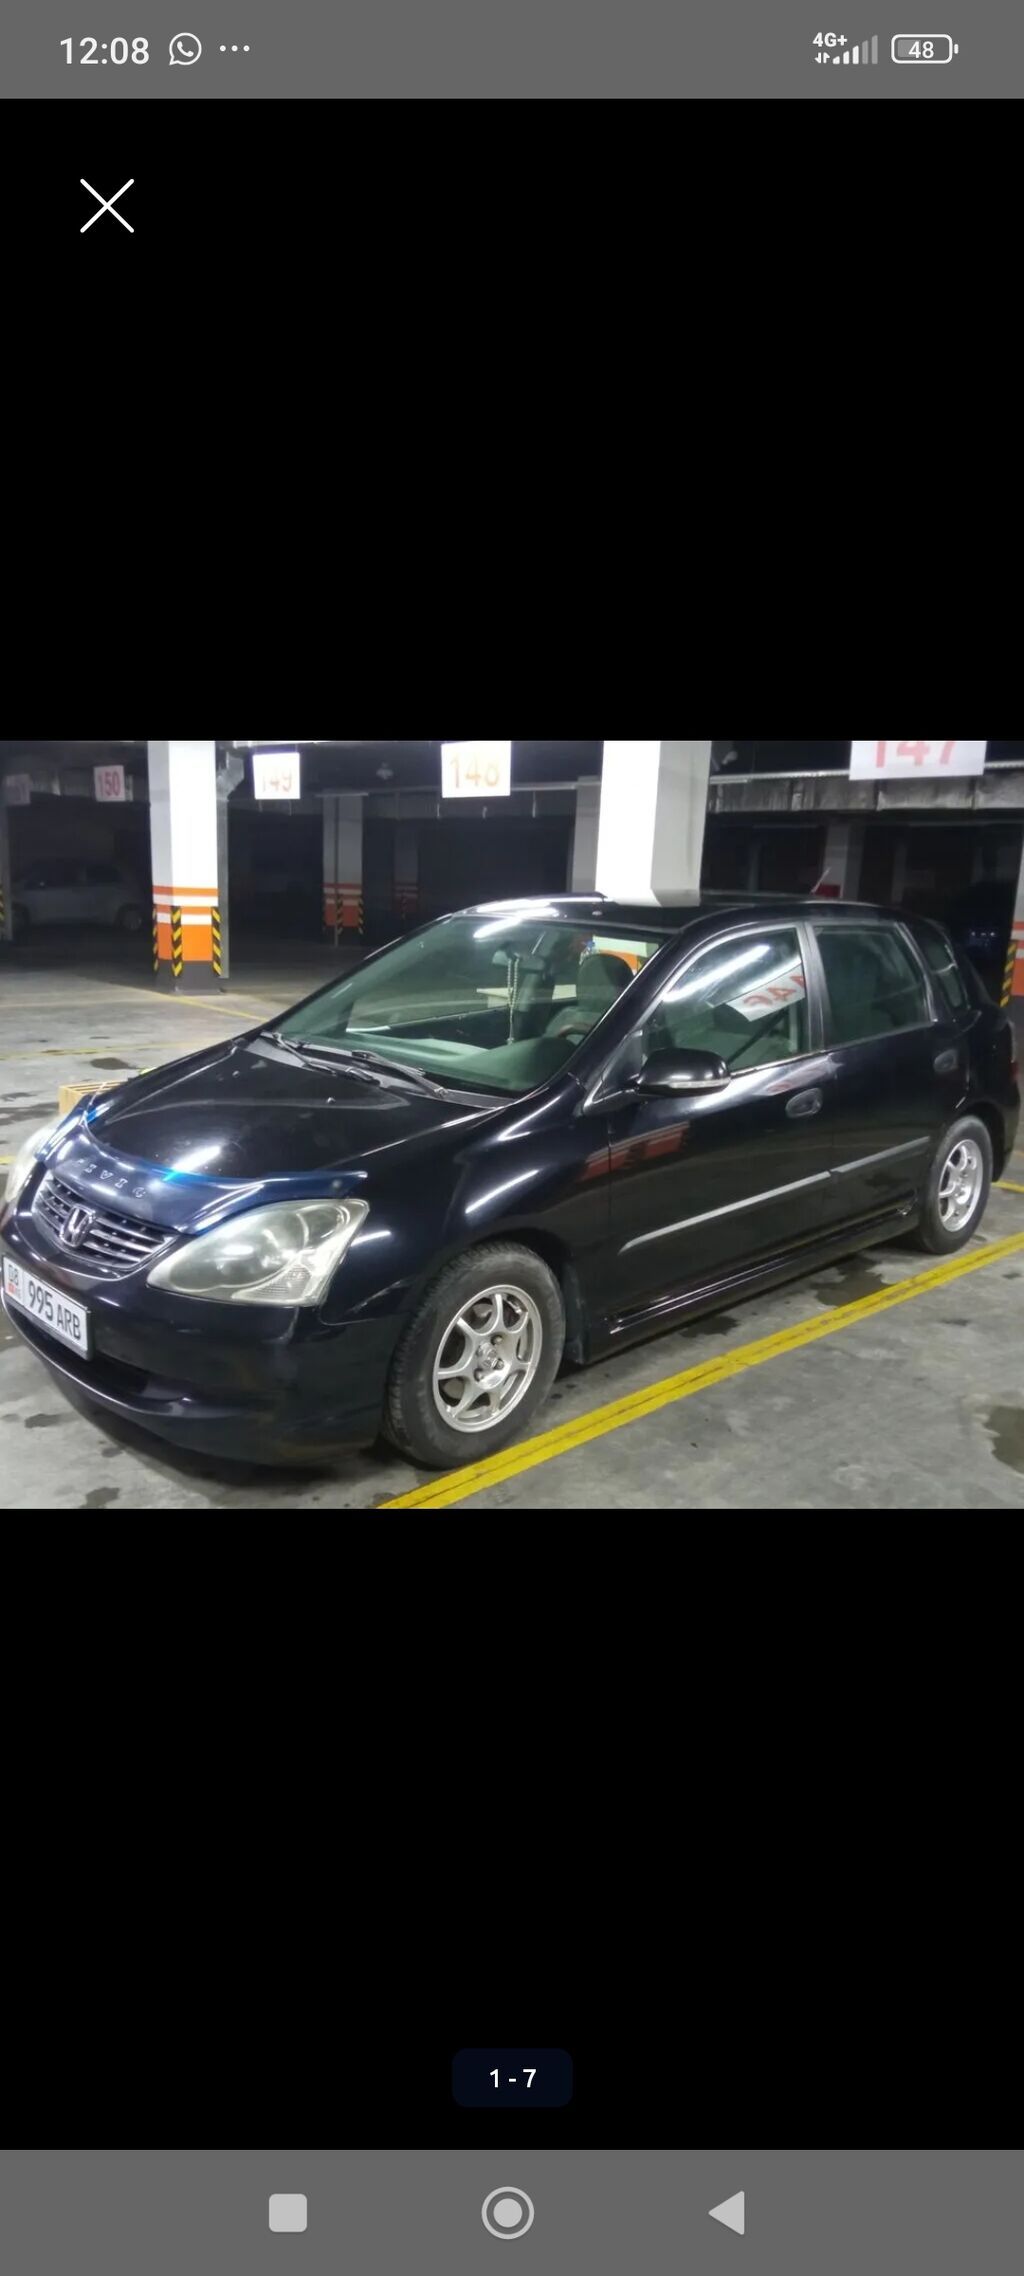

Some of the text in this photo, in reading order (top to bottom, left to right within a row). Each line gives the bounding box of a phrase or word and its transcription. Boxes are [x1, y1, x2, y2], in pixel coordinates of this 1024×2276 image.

[97, 771, 121, 797] 150
[28, 1280, 54, 1322] 995
[56, 1303, 82, 1341] ARB
